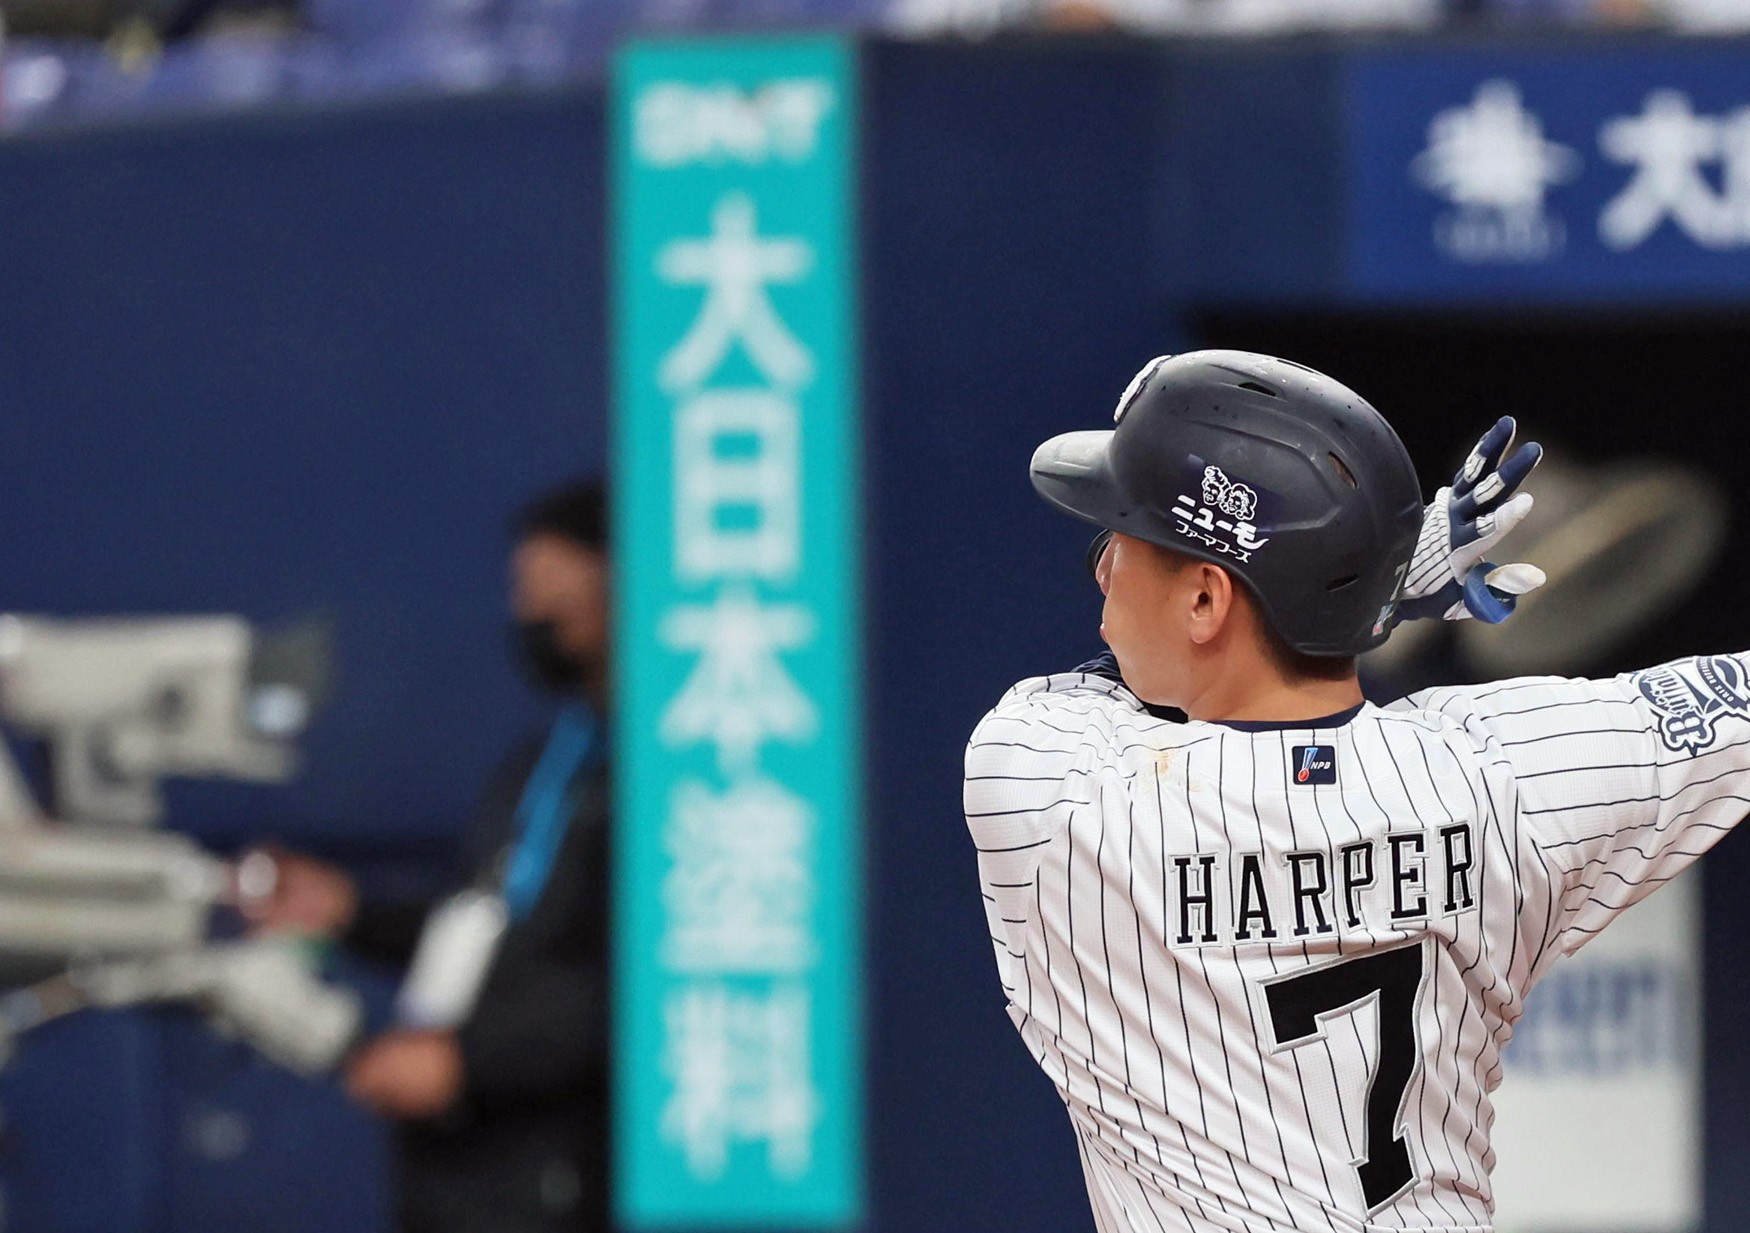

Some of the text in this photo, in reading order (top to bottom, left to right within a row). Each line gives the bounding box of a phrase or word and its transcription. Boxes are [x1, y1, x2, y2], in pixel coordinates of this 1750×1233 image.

[1171, 494, 1269, 550] ニューモ
[1175, 519, 1252, 563] ファーマフーズ
[1714, 685, 1734, 703] ORIX
[1310, 761, 1331, 770] NPB
[1168, 821, 1478, 948] HARPER
[1255, 931, 1431, 1222] 7
